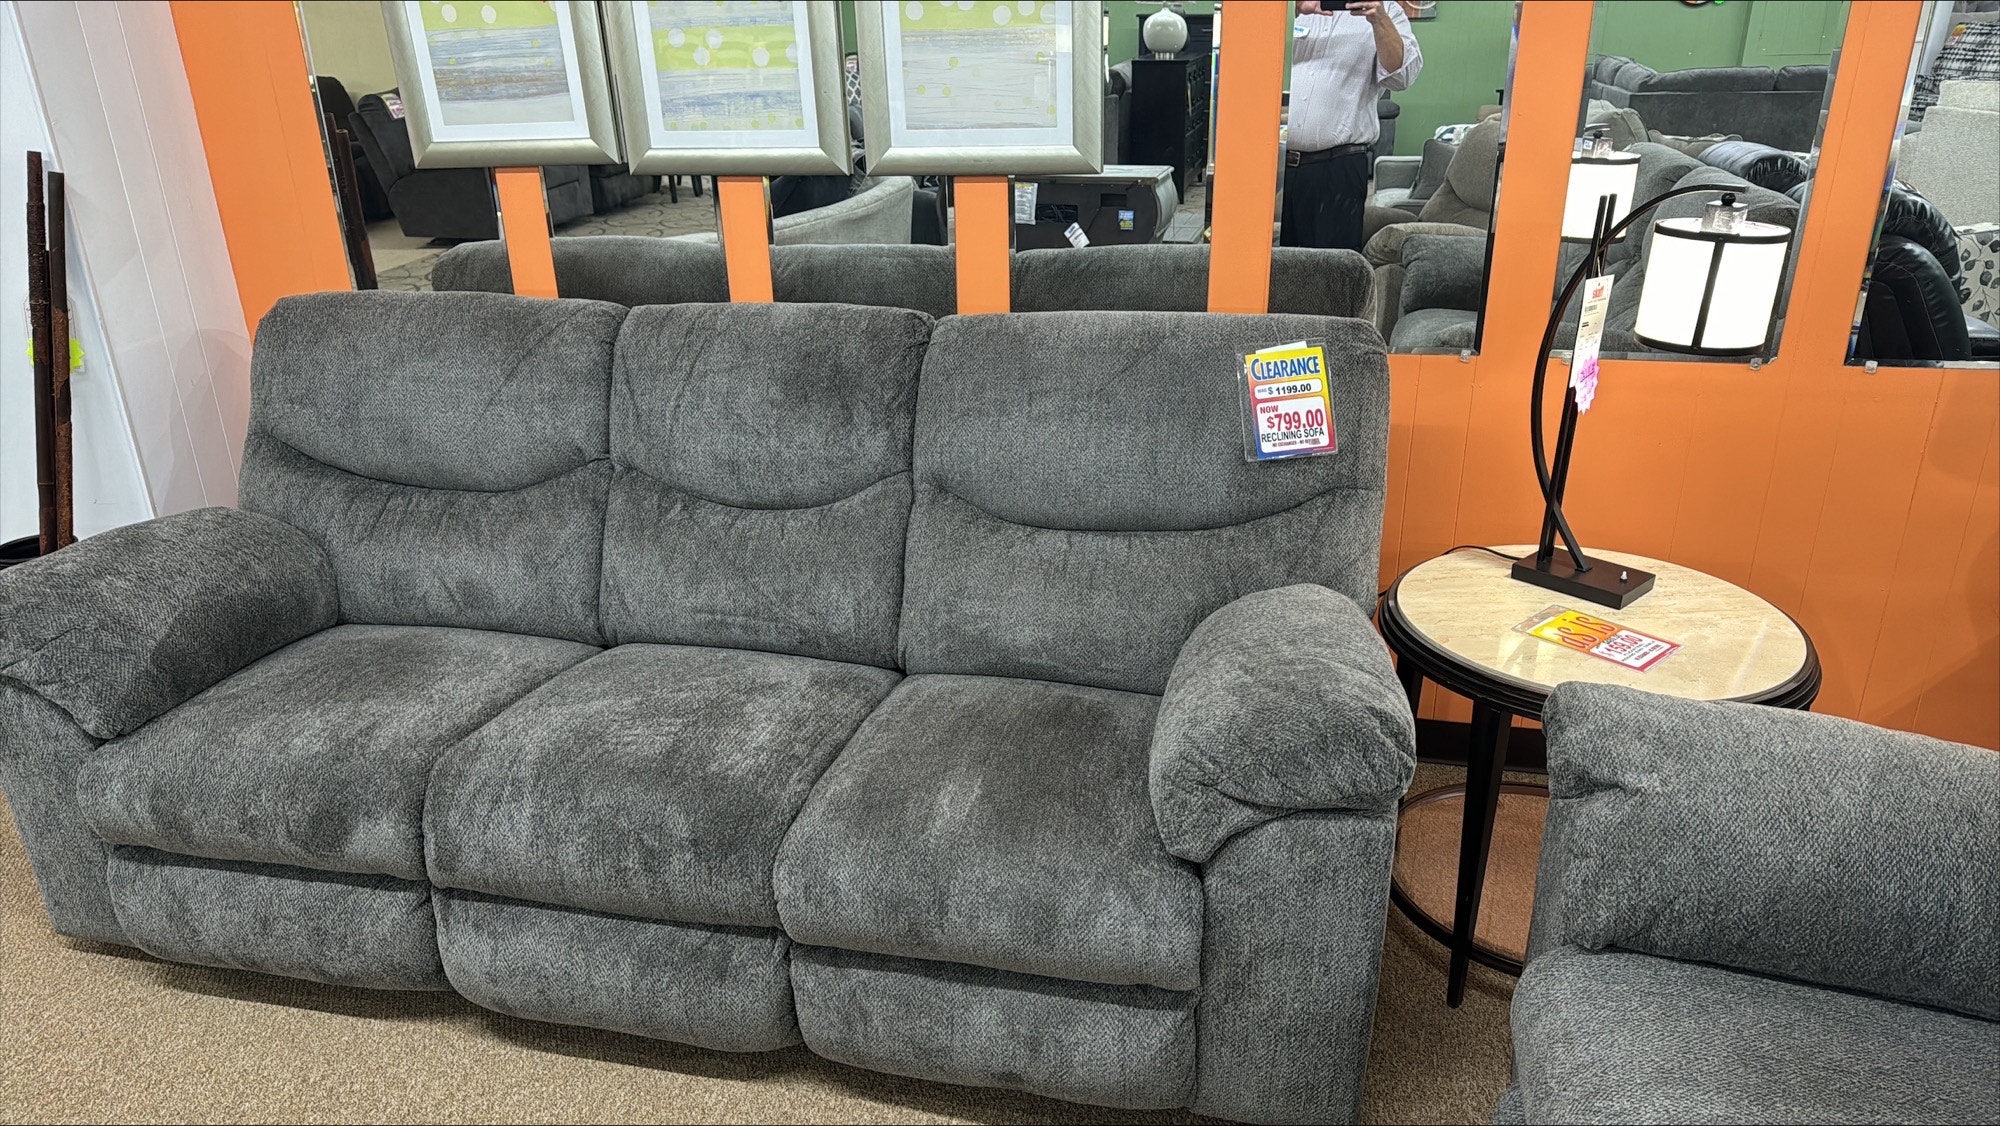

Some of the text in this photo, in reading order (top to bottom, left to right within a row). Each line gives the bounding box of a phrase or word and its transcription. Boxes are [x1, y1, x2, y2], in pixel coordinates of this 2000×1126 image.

[1250, 356, 1320, 381] CLEARANCE
[1268, 386, 1274, 395] $
[1275, 383, 1312, 396] 1199.00
[1260, 405, 1279, 414] NOW
[1266, 408, 1324, 432] $799.00
[1261, 427, 1325, 443] RECLINING SOFA
[1562, 616, 1616, 636] is
[1556, 626, 1599, 649] as
